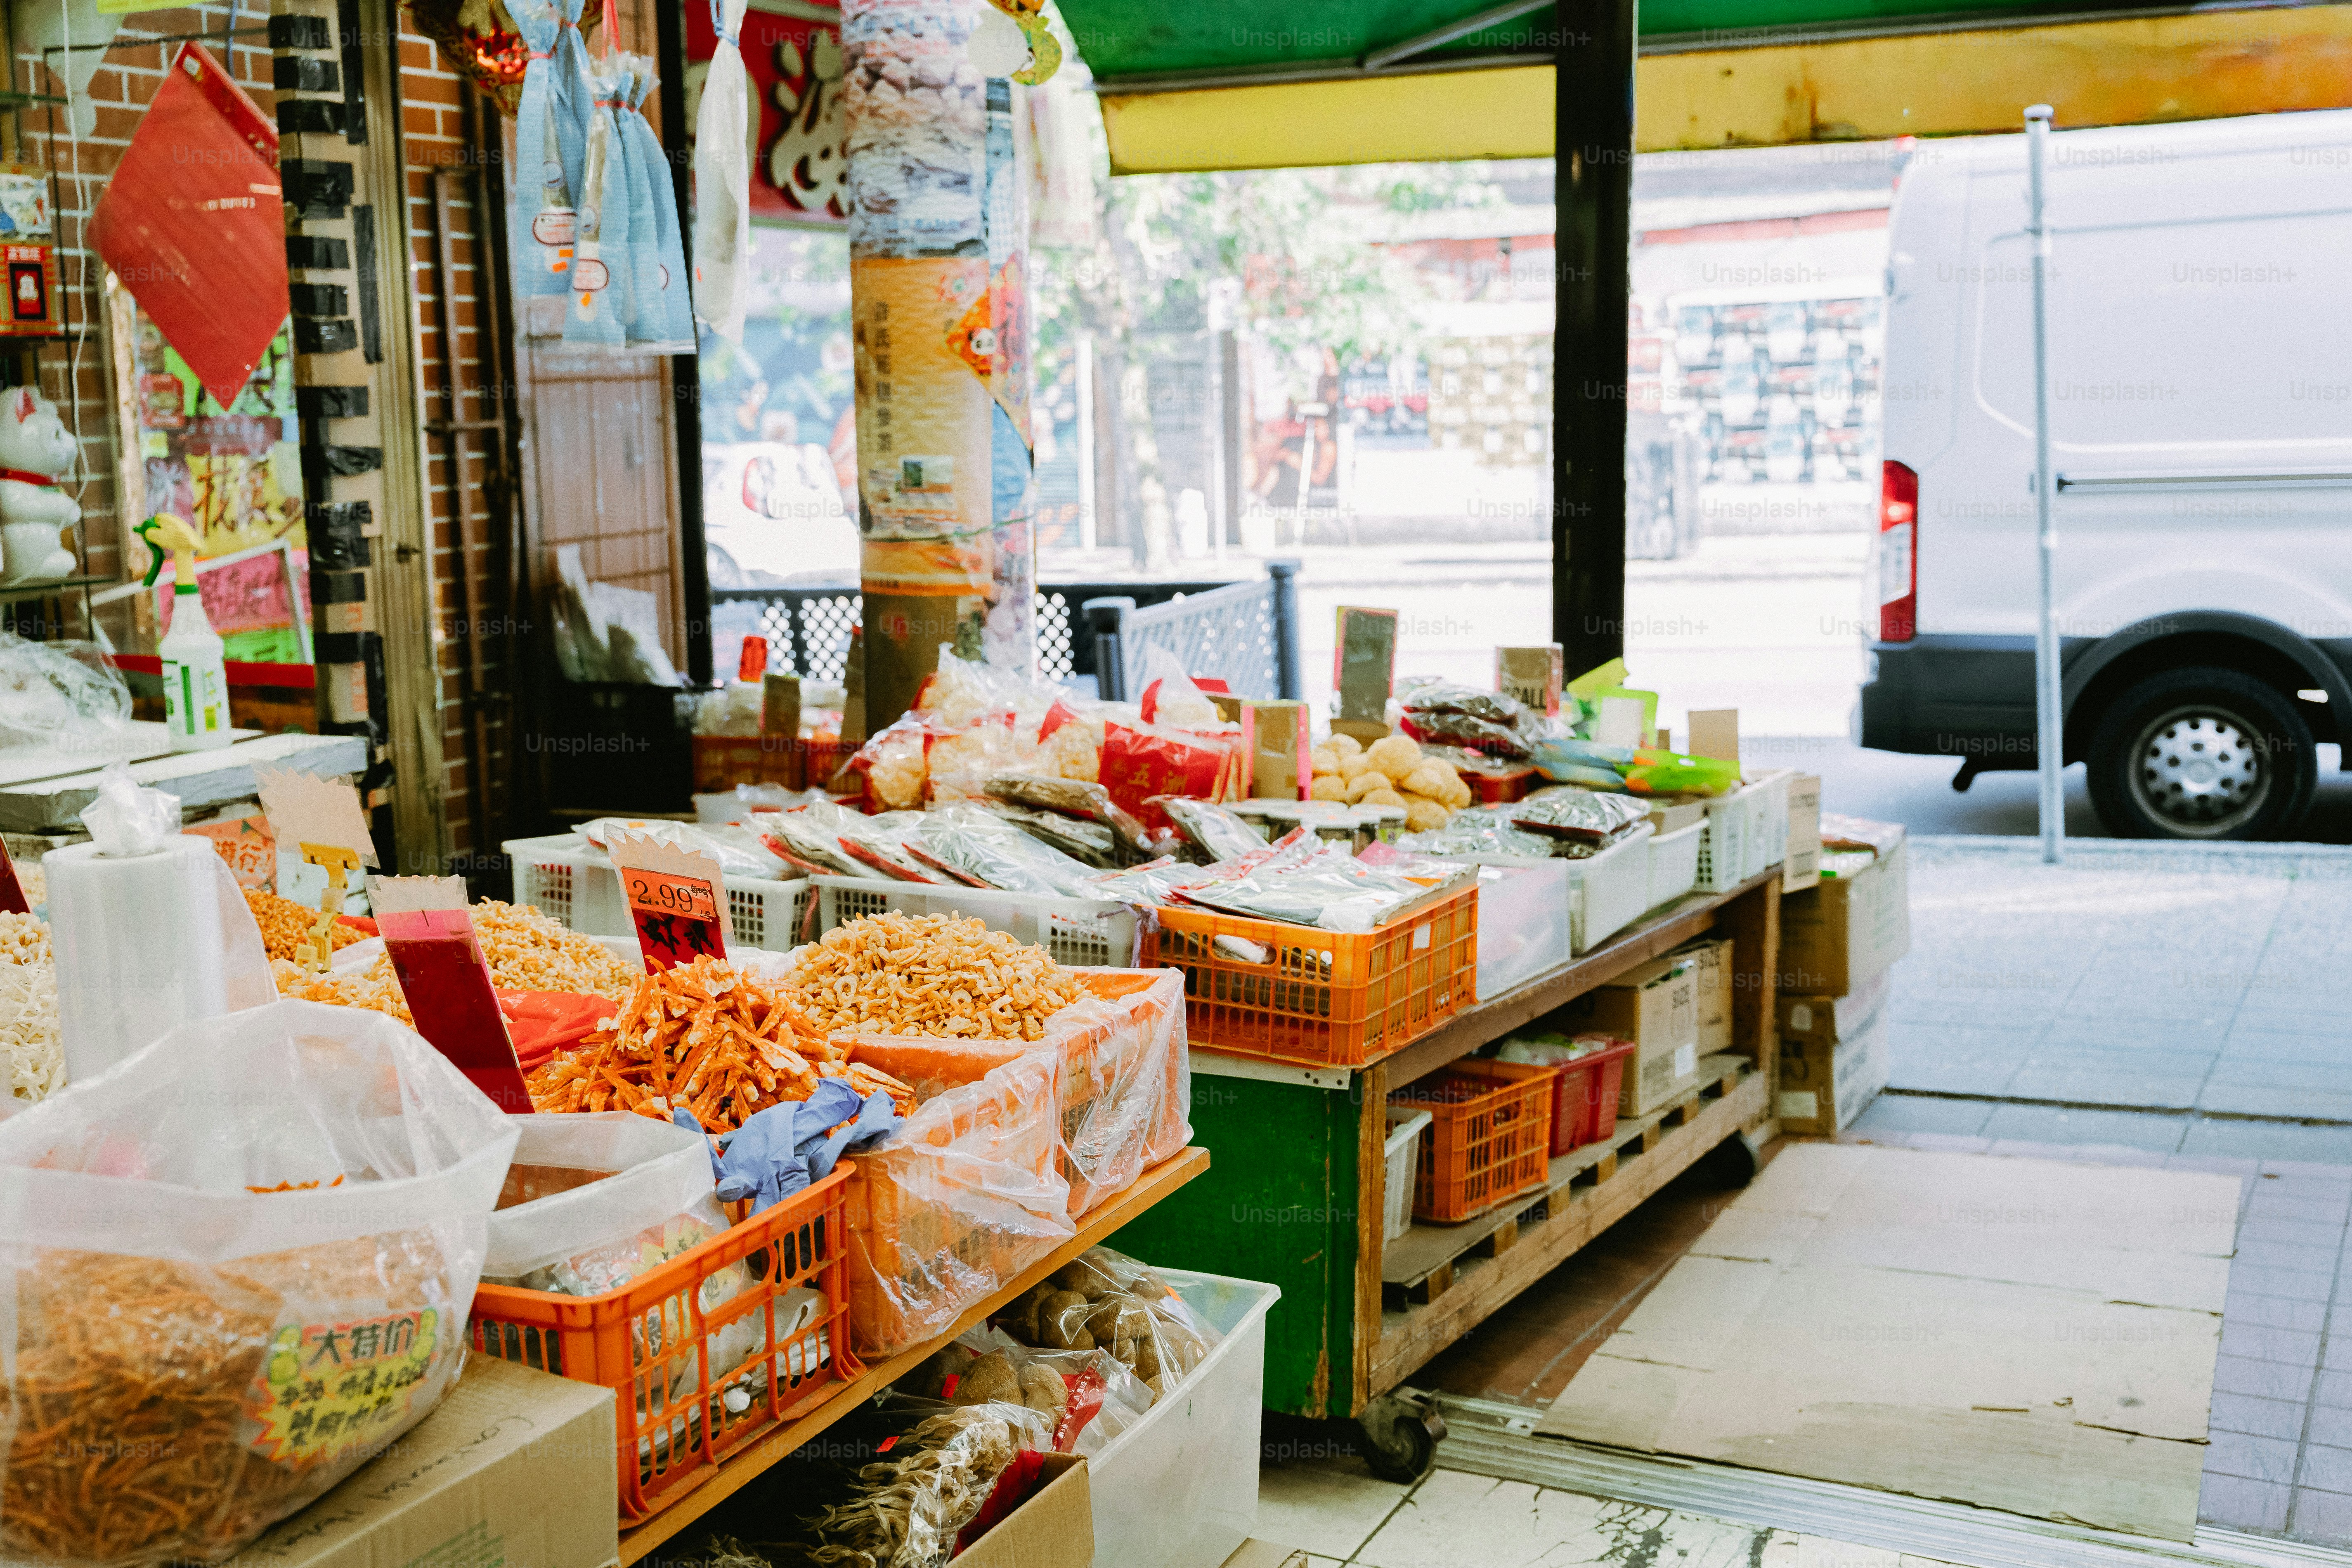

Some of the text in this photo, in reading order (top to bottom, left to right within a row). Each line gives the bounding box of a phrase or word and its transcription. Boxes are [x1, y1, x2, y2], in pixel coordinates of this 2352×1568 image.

[633, 880, 693, 913] 2.99
[308, 1317, 414, 1365] 大特价
